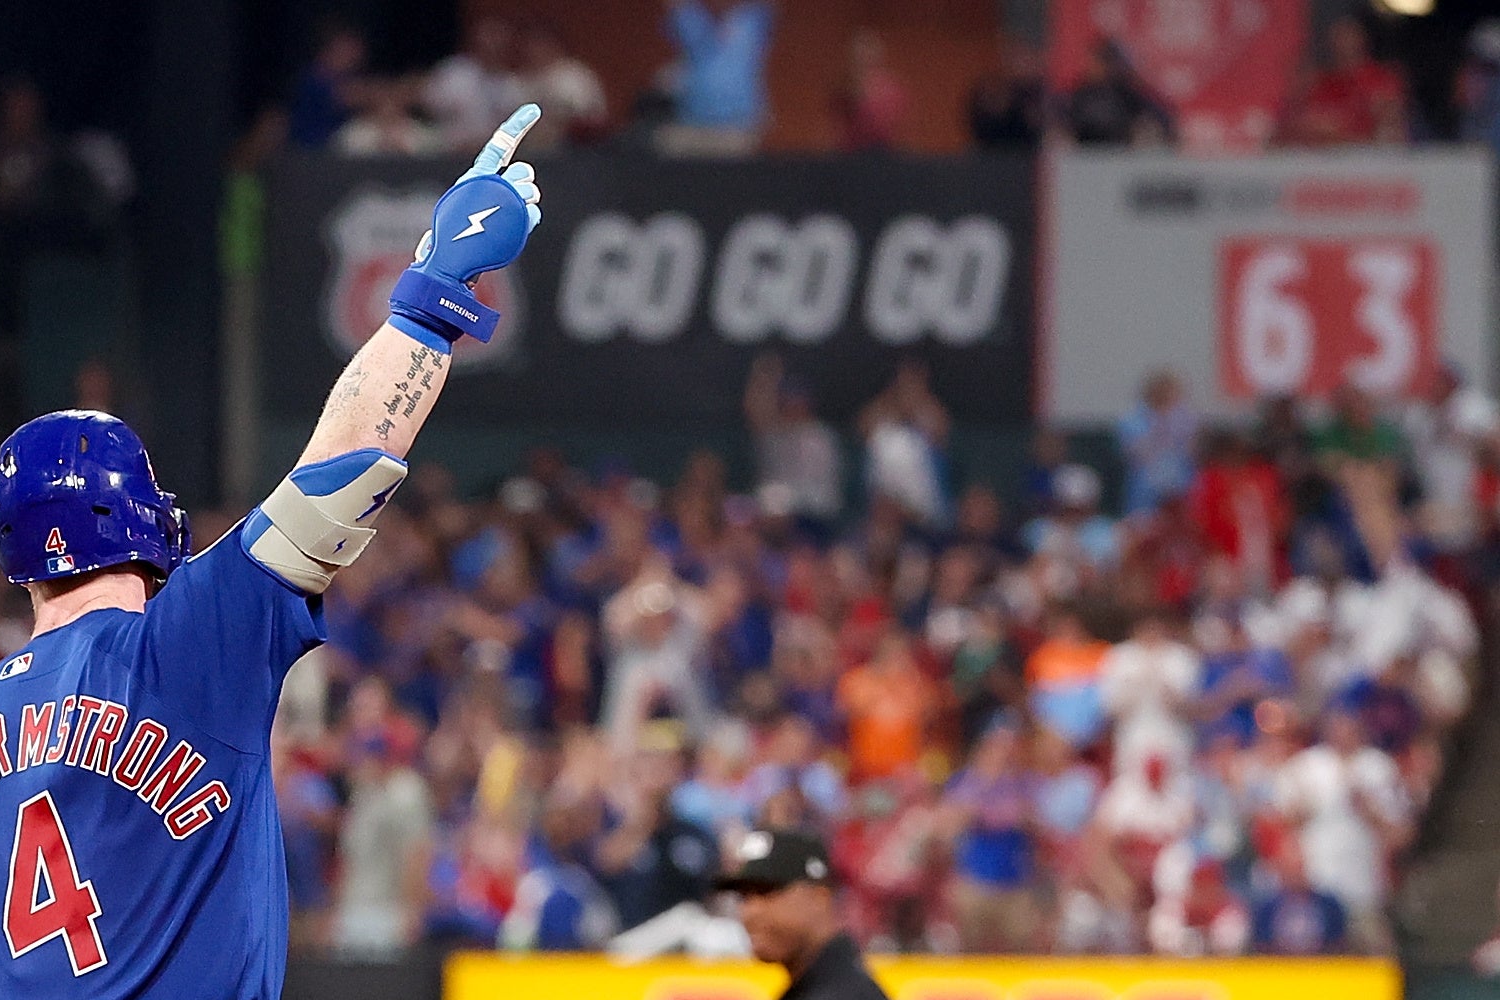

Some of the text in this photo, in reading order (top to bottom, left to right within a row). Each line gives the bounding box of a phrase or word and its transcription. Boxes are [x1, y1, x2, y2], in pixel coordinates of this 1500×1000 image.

[558, 211, 1011, 345] GO GO GO
[394, 382, 409, 393] to
[406, 346, 431, 380] anythin
[402, 390, 423, 419] makes
[420, 370, 434, 391] you
[45, 527, 66, 555] 4
[2, 789, 108, 978] 4
